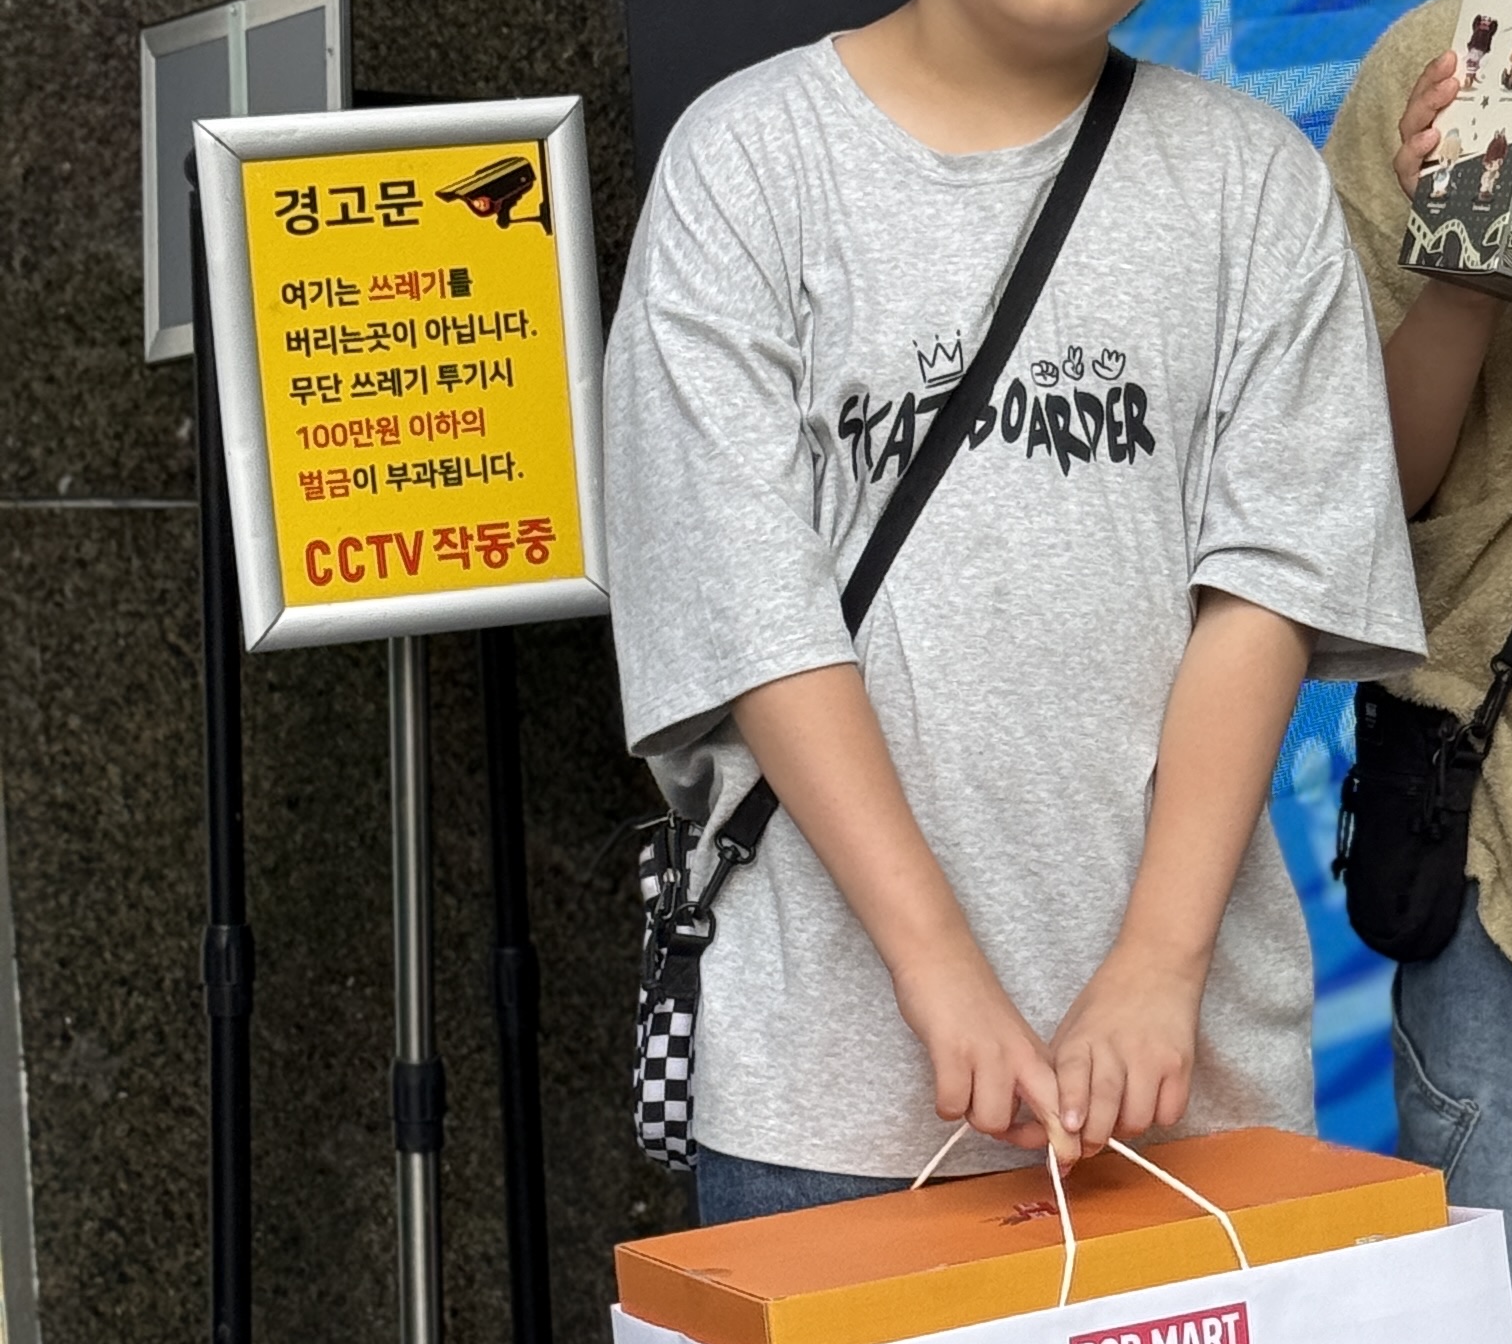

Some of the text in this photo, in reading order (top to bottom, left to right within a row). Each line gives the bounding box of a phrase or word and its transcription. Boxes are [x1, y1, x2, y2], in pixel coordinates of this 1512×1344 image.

[275, 180, 423, 235] 경고문
[281, 267, 473, 310] 여기는 쓰레기를
[286, 309, 538, 358] 버리는곳이 아닙니다.
[289, 357, 515, 406] 무단 쓰레기 투기시
[296, 407, 486, 450] 100만원 이하의
[298, 451, 525, 502] 벌금이 부과됩니다.
[305, 517, 557, 587] CCTV 작동중
